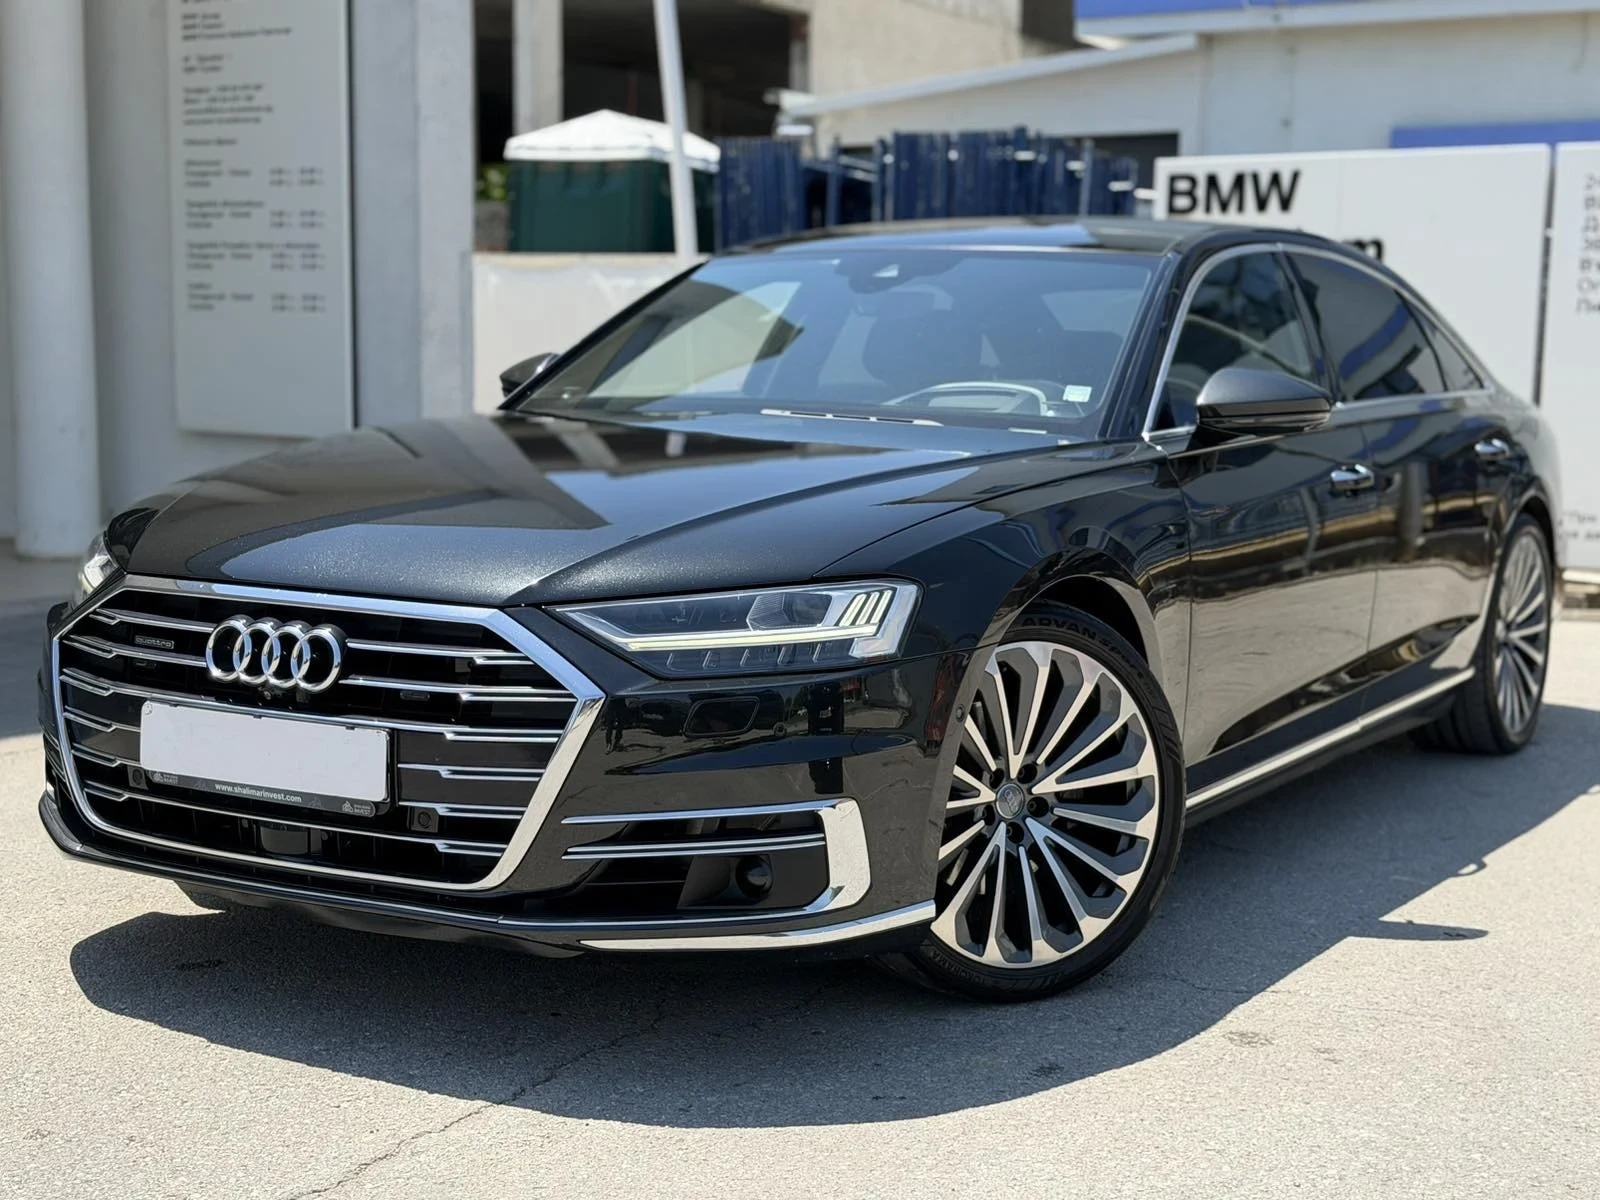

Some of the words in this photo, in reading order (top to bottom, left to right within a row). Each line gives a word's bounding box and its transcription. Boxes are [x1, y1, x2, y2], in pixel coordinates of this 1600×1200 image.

[1168, 169, 1301, 214] BMW
[1022, 616, 1098, 641] ADVAN
[214, 783, 302, 803] www.shalimarinvest.com
